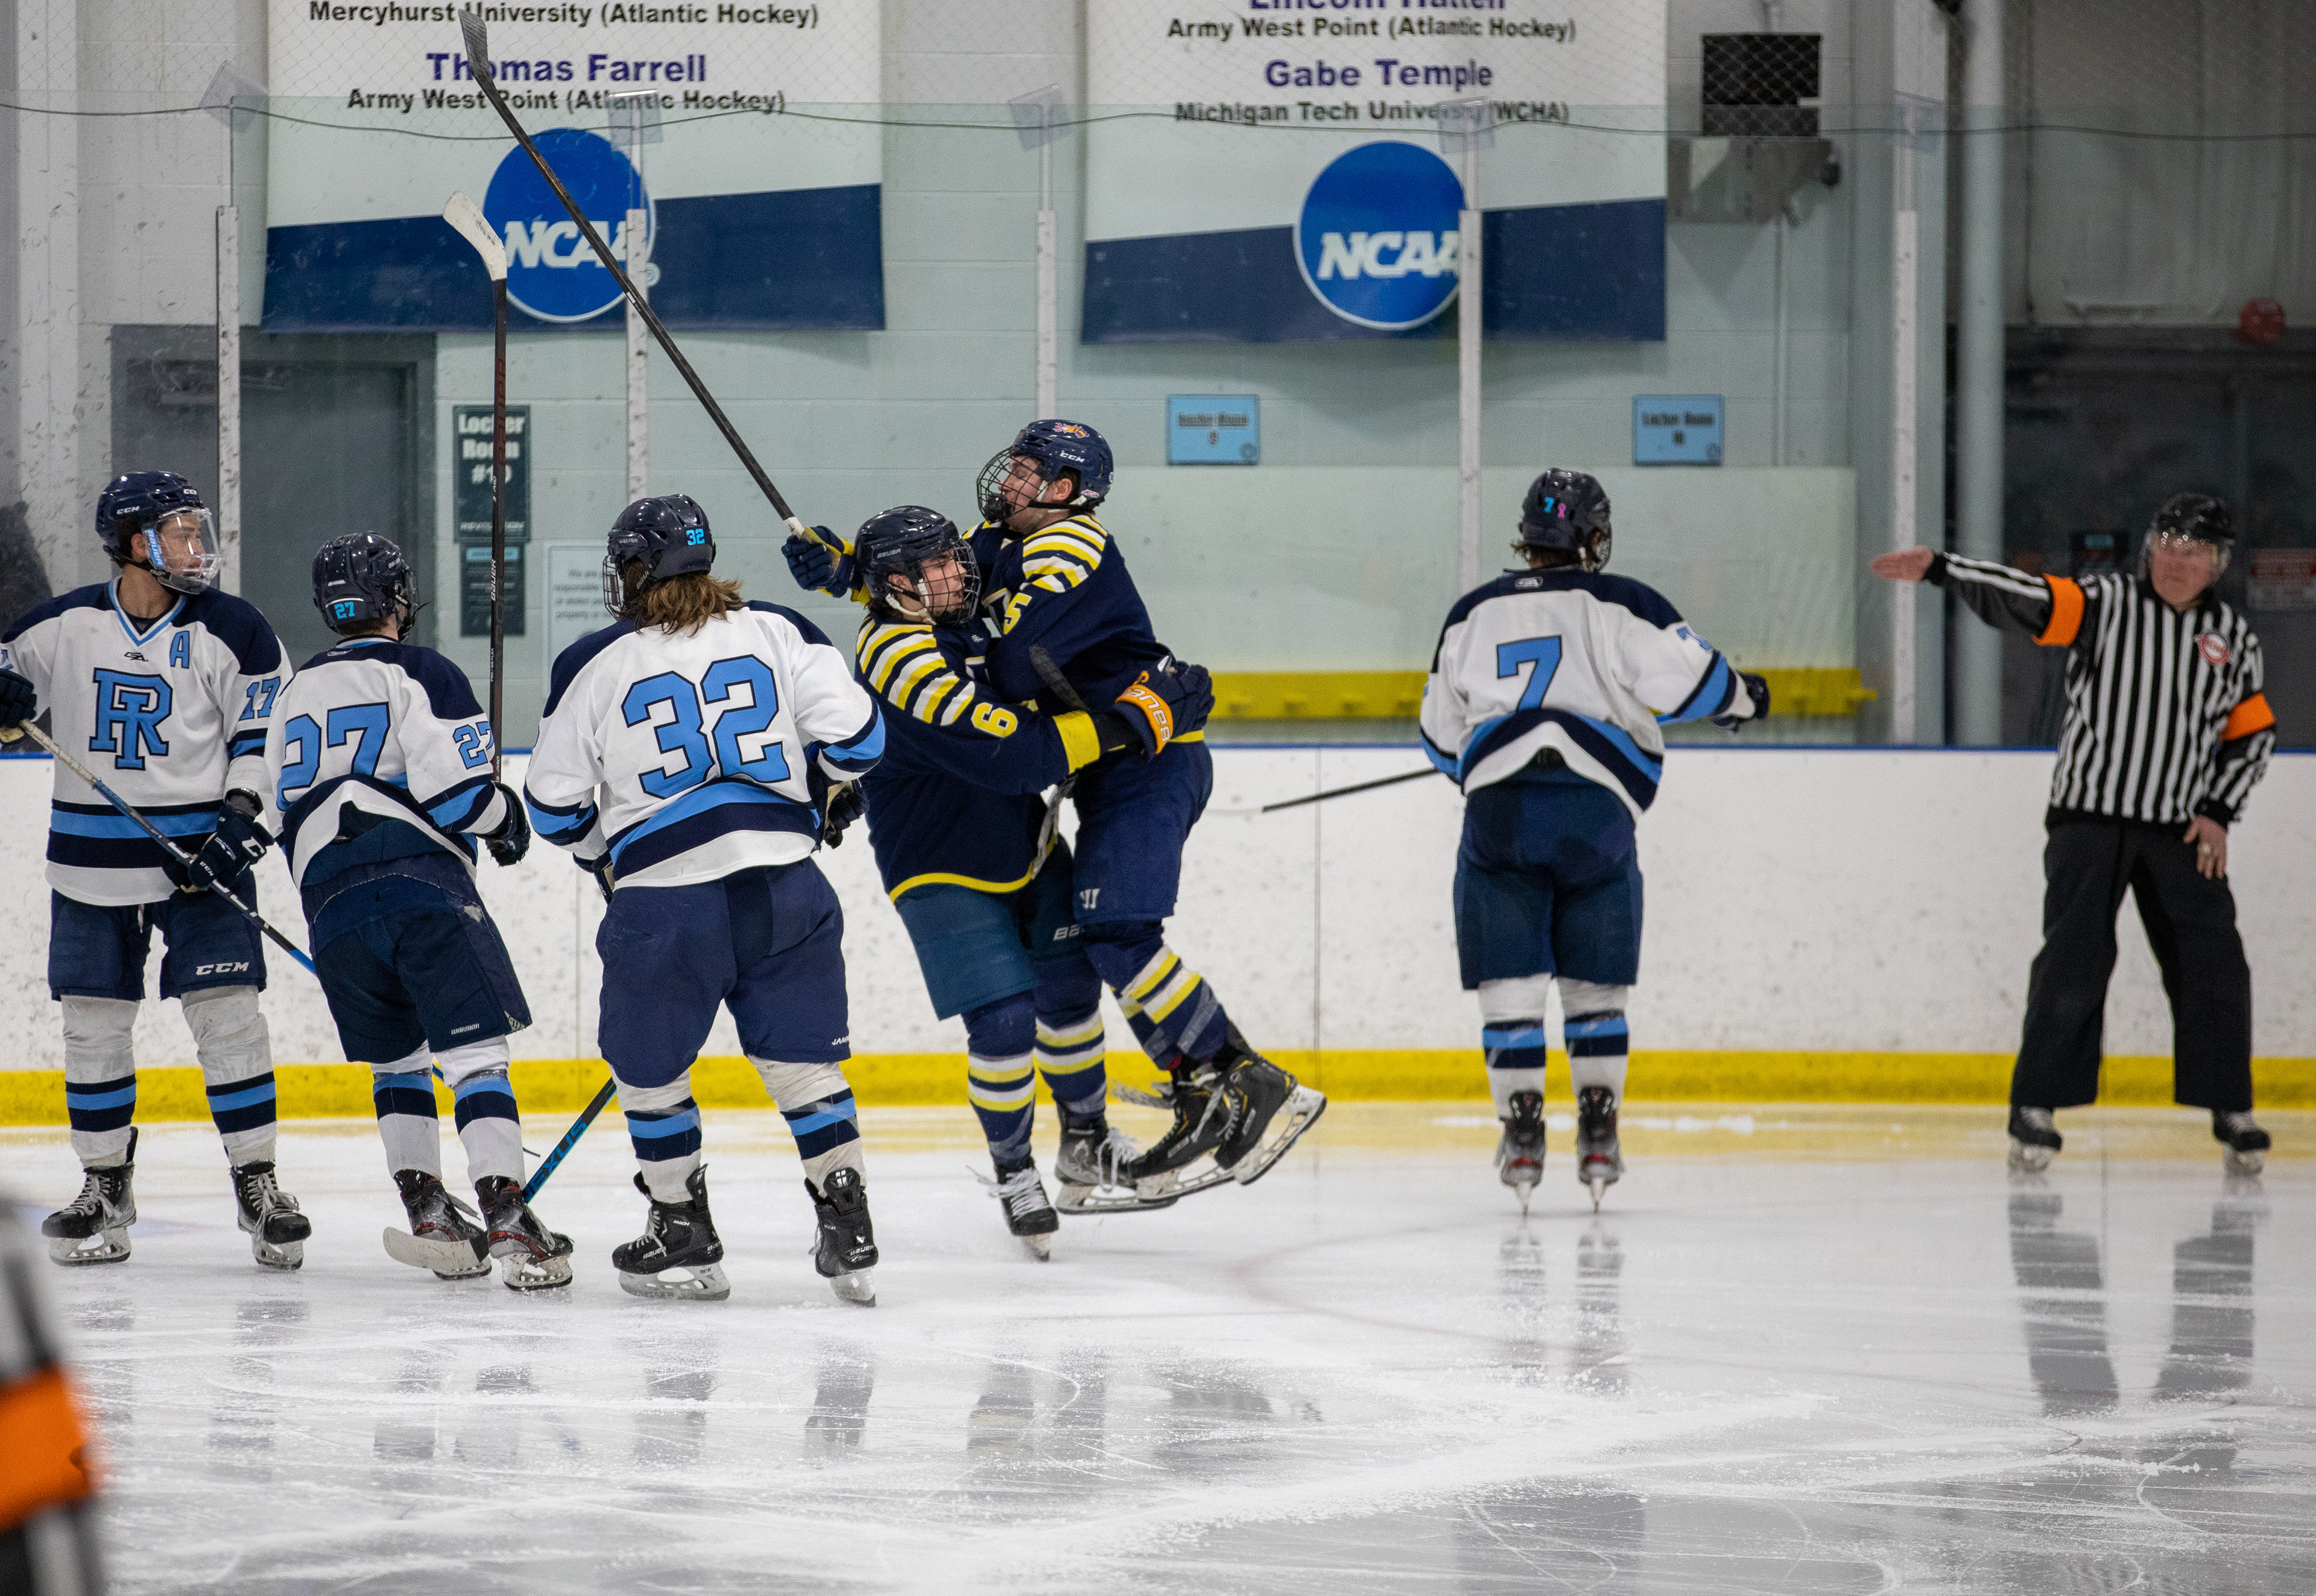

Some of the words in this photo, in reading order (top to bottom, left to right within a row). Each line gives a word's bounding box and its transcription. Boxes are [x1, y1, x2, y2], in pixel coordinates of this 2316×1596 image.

[309, 1, 455, 26] Mercyhurst
[601, 3, 707, 28] (Atlantic
[717, 4, 818, 28] Hockey)
[1167, 18, 1233, 42] Army
[1242, 17, 1305, 37] West
[1313, 17, 1379, 37] Point
[1388, 17, 1482, 39] (Atlantic
[1489, 19, 1576, 42] Hockey)
[587, 54, 707, 82] Farrell
[1265, 60, 1361, 87] Gabe
[1375, 59, 1493, 91] Temple
[347, 88, 414, 113] Army
[422, 89, 486, 109] West
[683, 90, 785, 114] Hockey)
[1175, 102, 1289, 125] Michigan
[1297, 101, 1359, 121] Tech
[1060, 452, 1085, 463] CCM
[116, 506, 140, 515] CCM
[1544, 496, 1555, 514] 7
[148, 528, 165, 567] BAUER
[686, 529, 706, 545] 32
[334, 601, 355, 619] 27
[169, 630, 190, 669] A
[1496, 635, 1562, 713] 7
[240, 677, 281, 721] 17
[621, 654, 791, 800] 32
[971, 702, 1018, 739] 6
[276, 701, 391, 811] 27
[453, 721, 493, 769] 27
[195, 962, 250, 976] CCM
[451, 1023, 479, 1035] WARRIOR
[850, 1245, 875, 1256] BAUER
